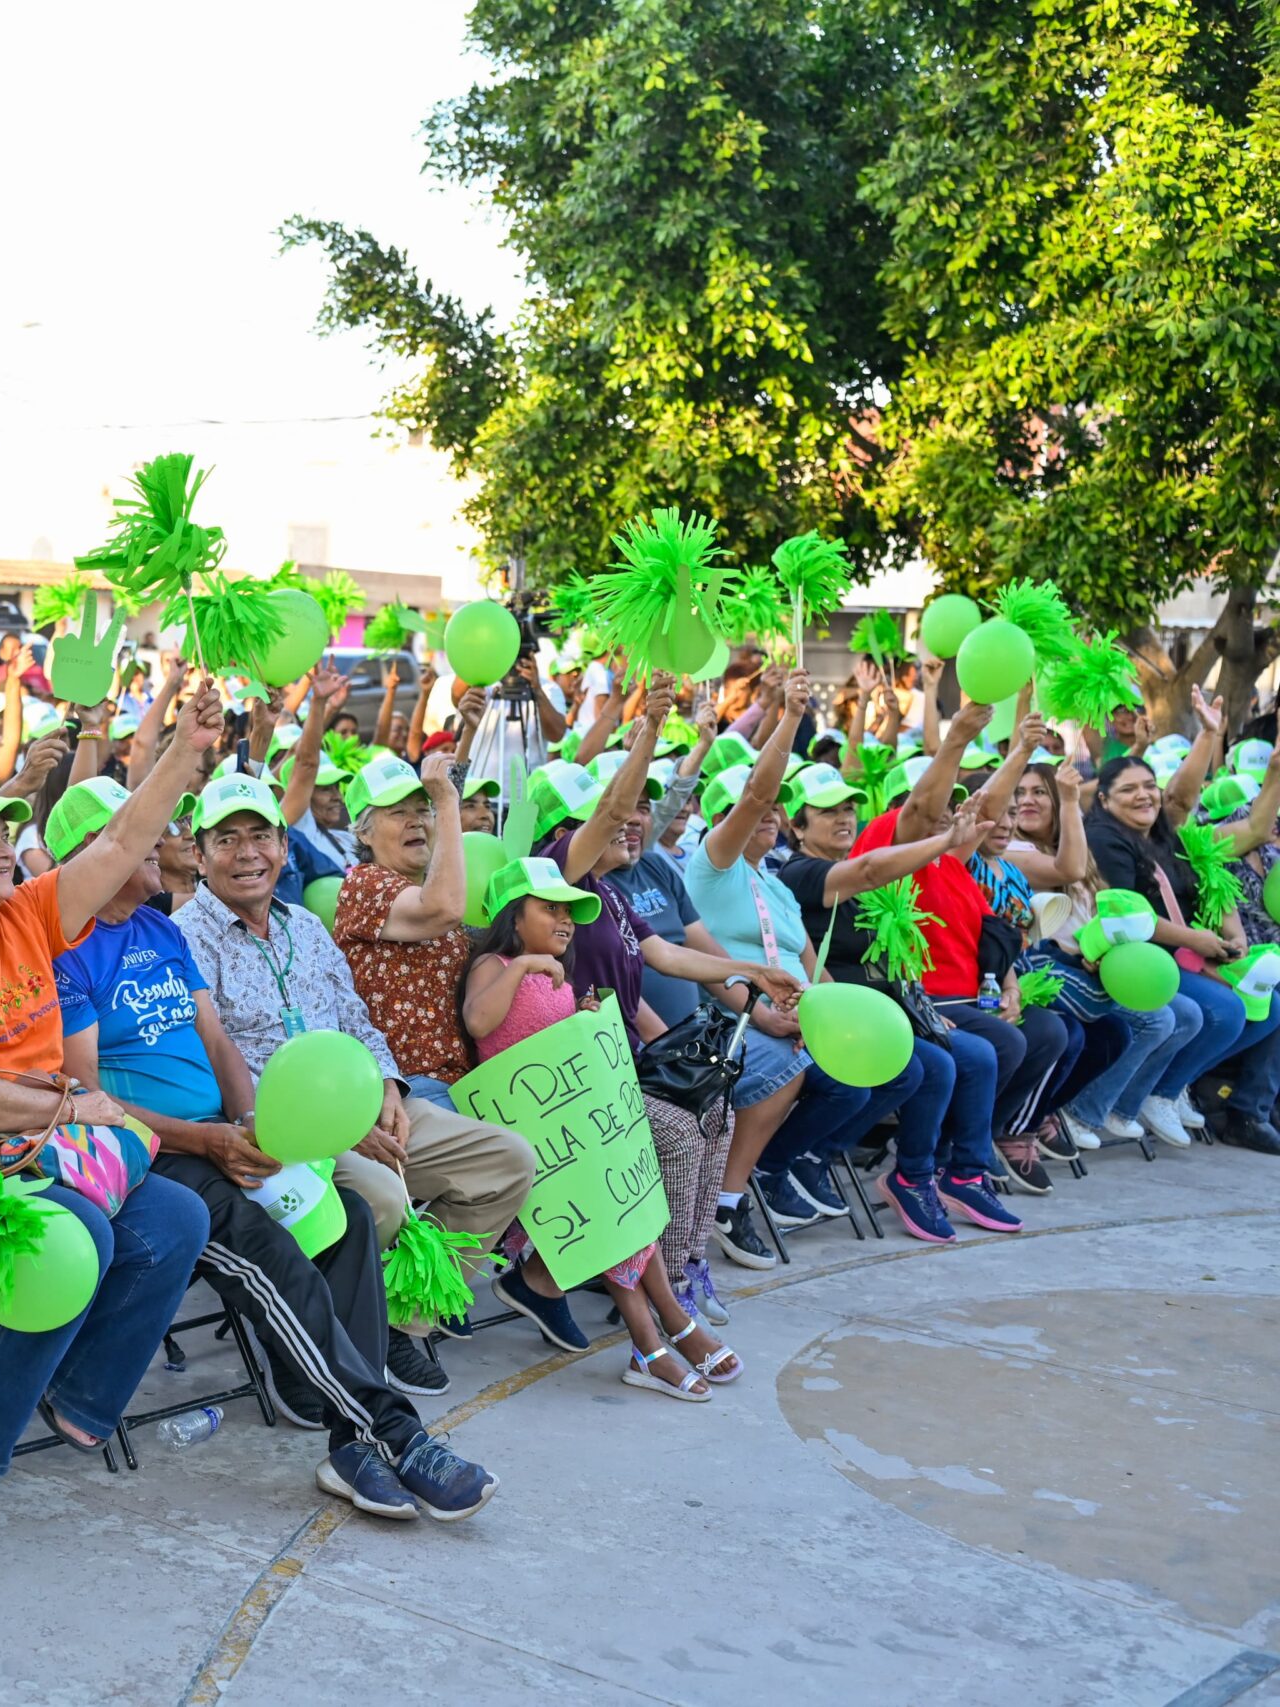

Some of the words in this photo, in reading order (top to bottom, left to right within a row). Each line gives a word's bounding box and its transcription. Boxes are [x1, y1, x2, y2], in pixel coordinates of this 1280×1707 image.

[111, 966, 196, 1015] Ready
[7, 1021, 28, 1038] Luis
[509, 1052, 589, 1106] DIF
[588, 1102, 625, 1138] DE
[531, 1200, 592, 1240] SI
